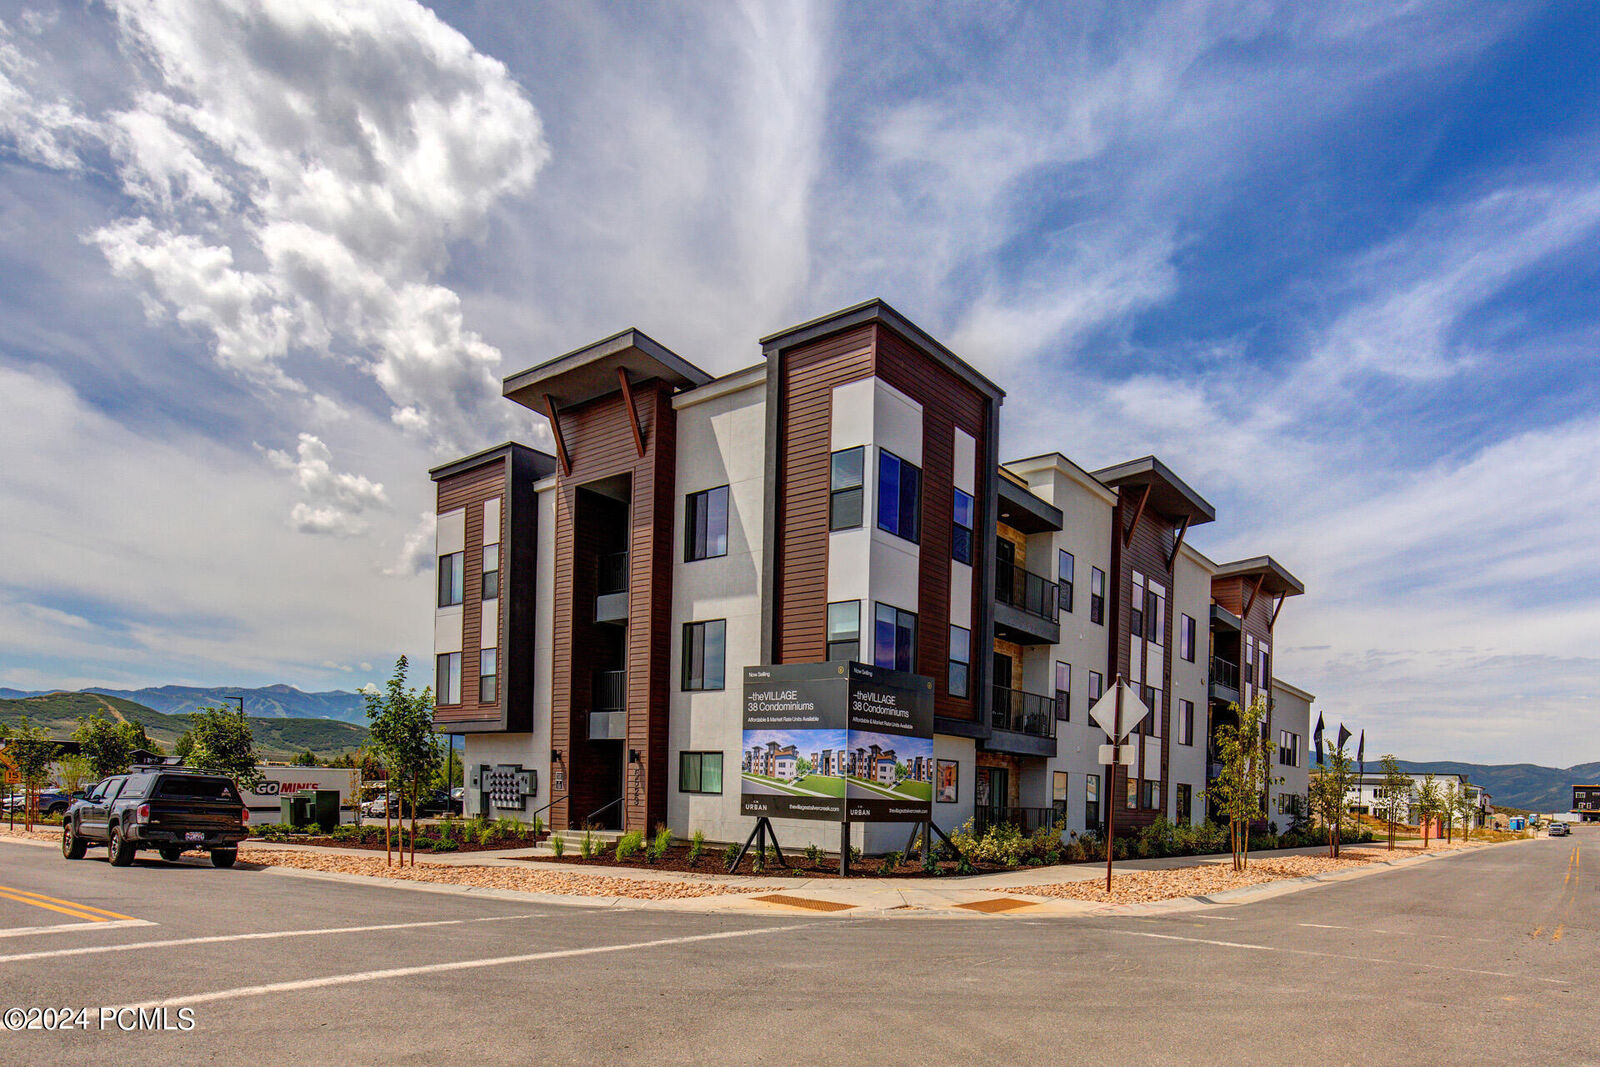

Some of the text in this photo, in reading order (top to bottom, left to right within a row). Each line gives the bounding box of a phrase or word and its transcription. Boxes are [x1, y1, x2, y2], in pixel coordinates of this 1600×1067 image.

[862, 670, 873, 678] Selling
[748, 701, 814, 712] 38 Condominiums
[852, 701, 910, 718] 38 Condominiums
[256, 783, 278, 794] GO
[745, 803, 768, 811] URBAN
